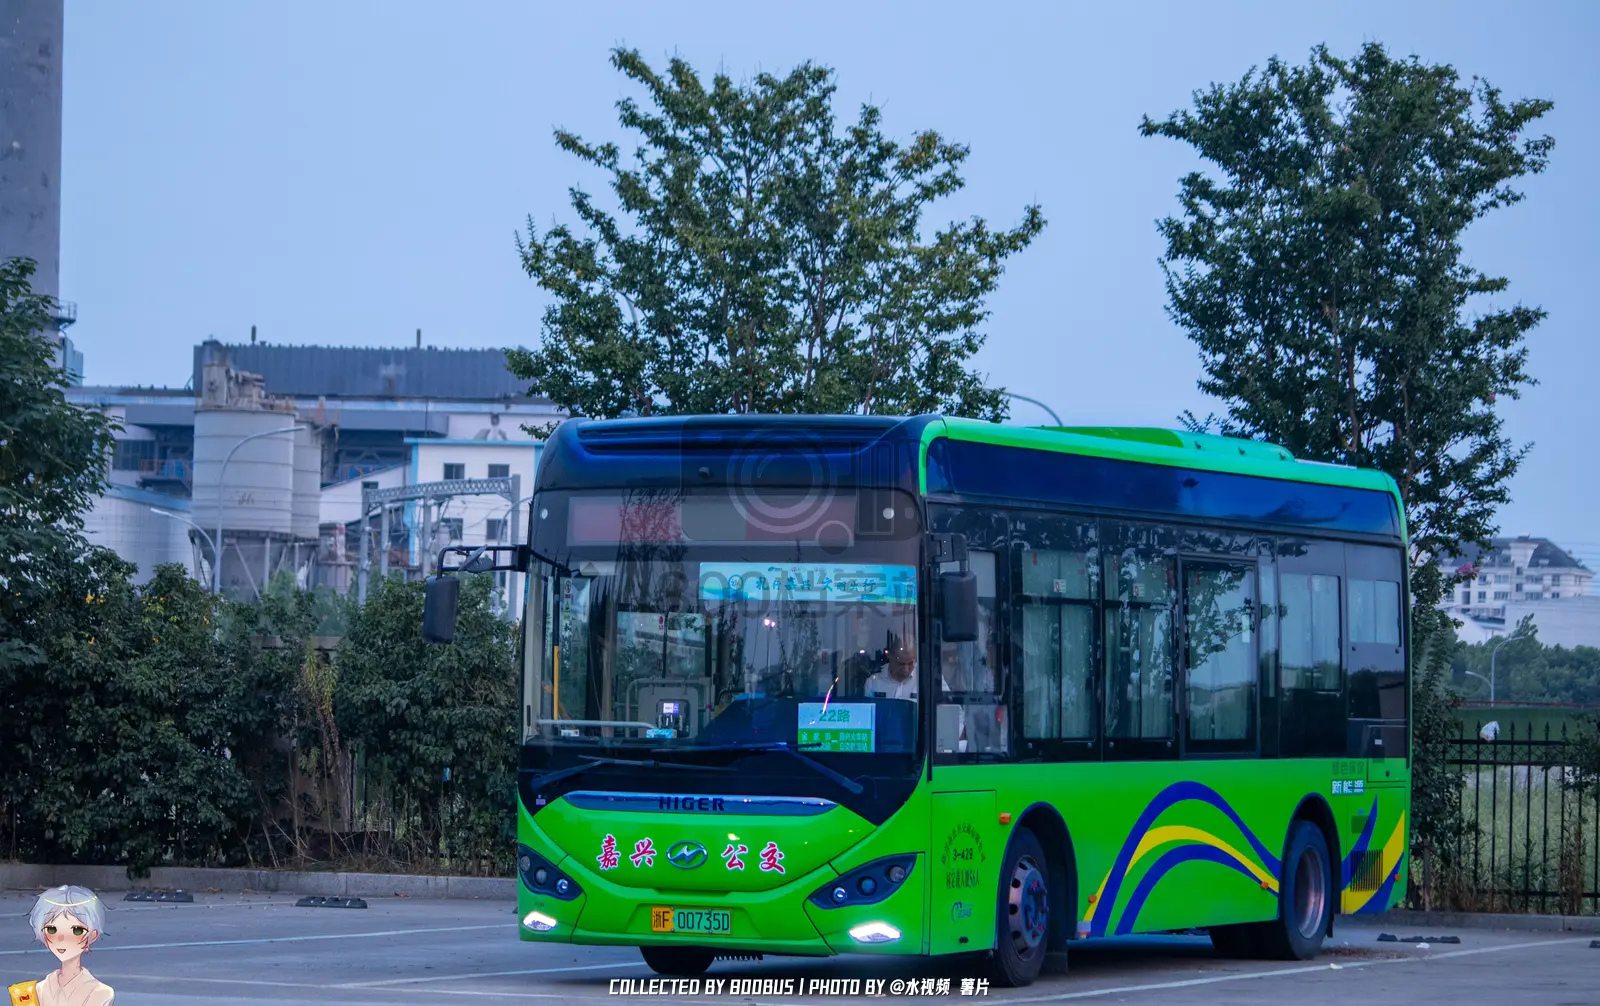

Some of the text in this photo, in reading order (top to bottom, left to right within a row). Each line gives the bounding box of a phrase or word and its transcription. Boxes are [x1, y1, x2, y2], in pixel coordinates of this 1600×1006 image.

[818, 708, 851, 723] 22路
[1332, 780, 1363, 794] 新能源
[659, 796, 725, 811] HIGER
[596, 833, 786, 874] 嘉兴 公交
[953, 845, 973, 860] 3-429
[653, 911, 730, 931] 浙F 00735D
